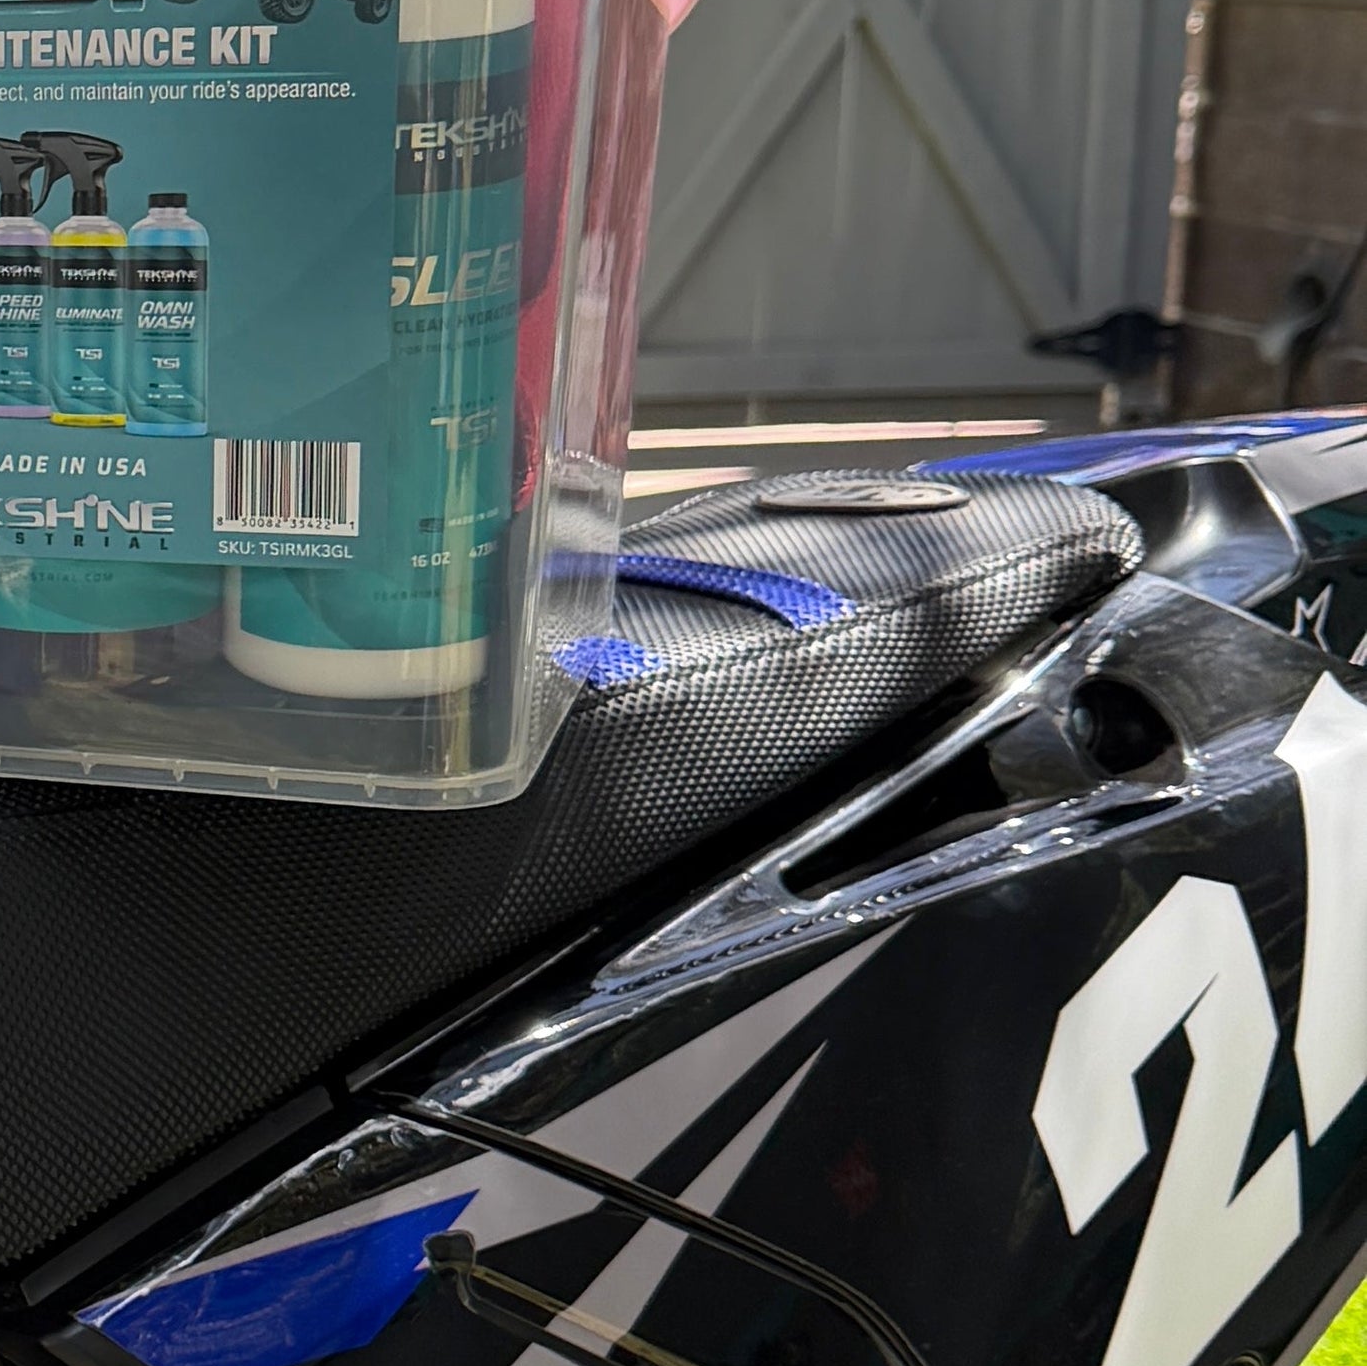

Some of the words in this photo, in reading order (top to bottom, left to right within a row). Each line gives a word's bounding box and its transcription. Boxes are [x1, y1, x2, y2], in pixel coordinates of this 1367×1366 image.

[209, 25, 278, 66] KIT
[32, 84, 64, 102] and
[70, 82, 143, 101] maintain
[149, 85, 187, 104] your
[192, 81, 239, 100] ride's
[245, 81, 357, 103] appearance.
[390, 240, 522, 308] SLEE
[56, 307, 123, 320] ELIMINATE
[140, 301, 194, 315] OMNI
[137, 316, 196, 330] WASH
[60, 456, 86, 475] IN
[97, 457, 147, 477] USA
[216, 517, 223, 526] 8
[349, 521, 355, 530] 1
[218, 540, 256, 555] SKU:
[259, 542, 354, 559] TSIRMK3GL
